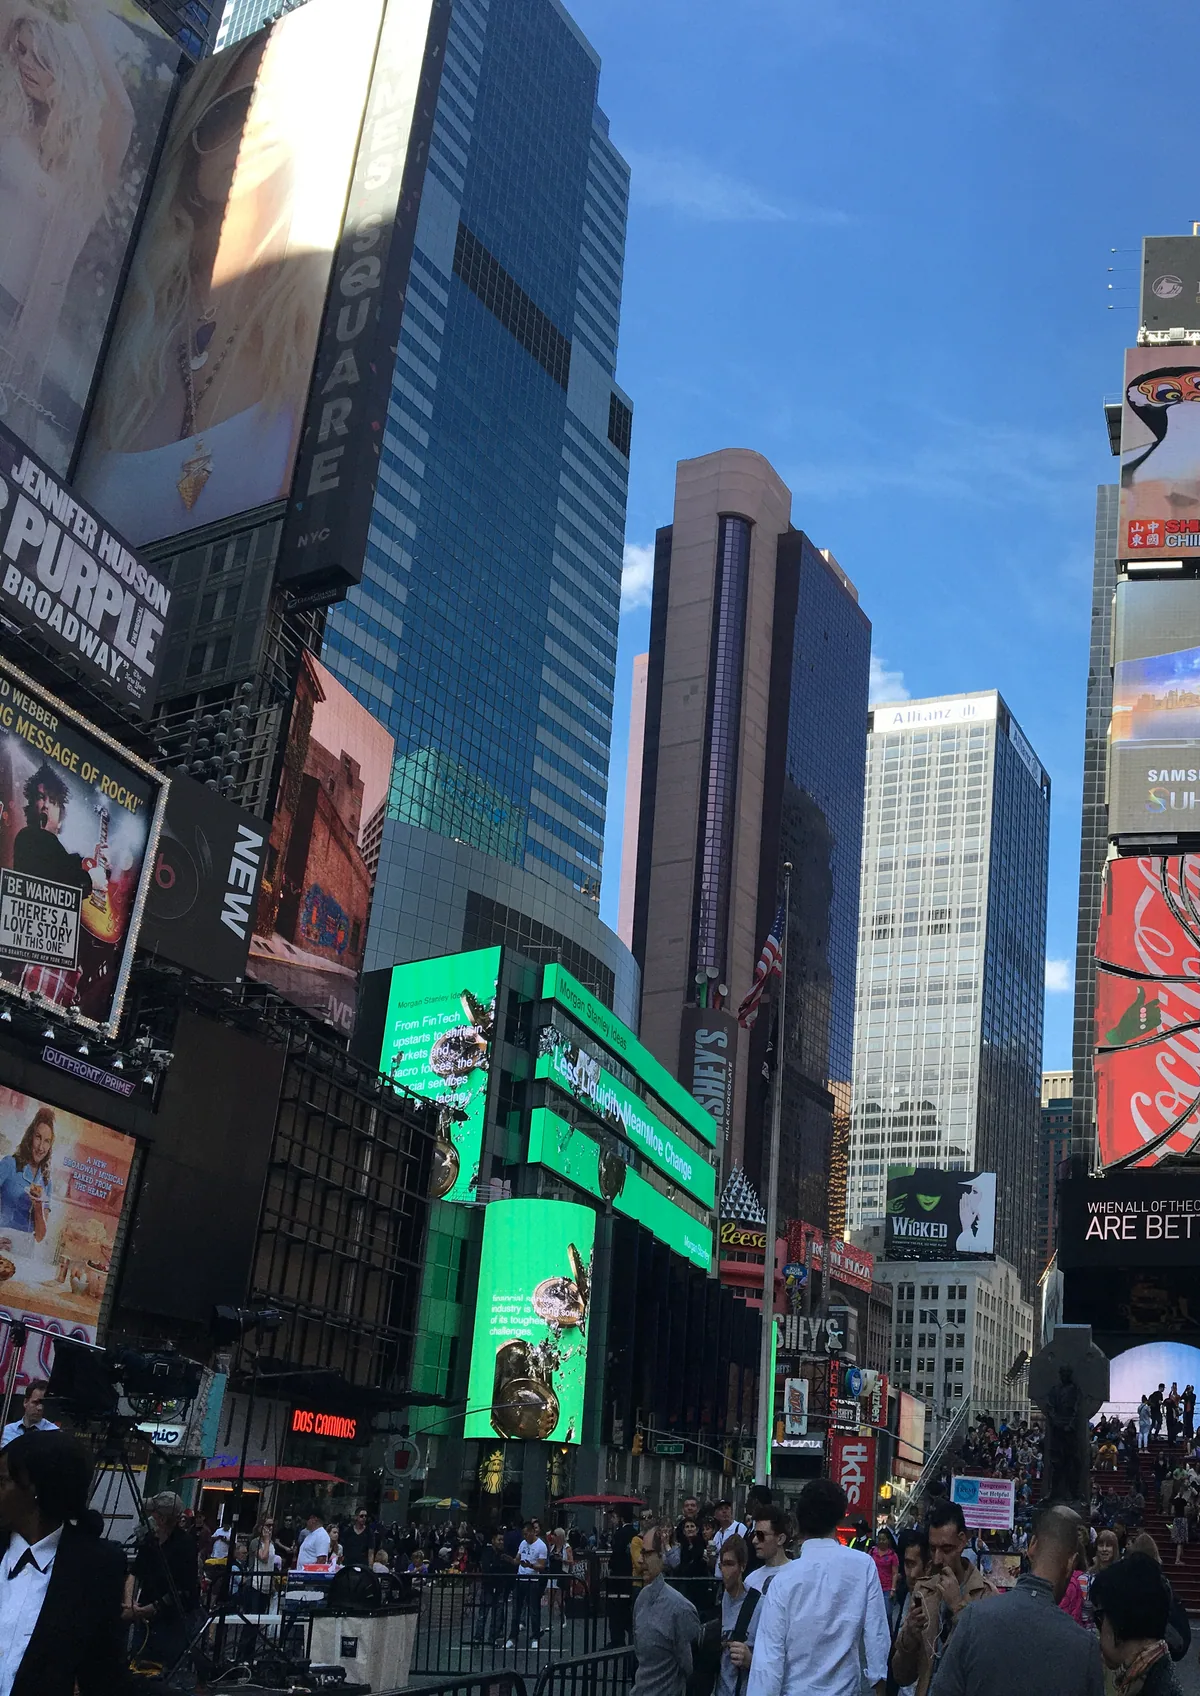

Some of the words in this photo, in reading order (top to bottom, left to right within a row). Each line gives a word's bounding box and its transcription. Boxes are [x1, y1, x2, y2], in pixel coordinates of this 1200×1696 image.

[307, 213, 385, 496] SQUARE
[11, 455, 98, 550] JENNIFER
[98, 529, 171, 617] HUDSON
[297, 527, 330, 548] NYC
[3, 493, 164, 678] PURPLE
[12, 687, 59, 733] WEBBER
[15, 715, 80, 773] MESSAGE
[81, 762, 100, 785] OF
[25, 880, 76, 909] WARNED!
[220, 824, 264, 941] NEW
[10, 899, 58, 925] THERE'S
[61, 912, 68, 928] A
[3, 915, 34, 936] LOVE
[36, 922, 73, 944] STORY
[12, 933, 22, 946] IN
[24, 935, 44, 950] THIS
[395, 1020, 419, 1032] From
[422, 1011, 461, 1027] FinTech
[559, 977, 586, 1013] Morgan
[586, 1003, 610, 1037] Stanley
[610, 1024, 627, 1050] Ideas
[393, 1033, 430, 1049] upstarts
[433, 1031, 442, 1040] to
[431, 1043, 450, 1057] and
[46, 1050, 101, 1081] OUTFRONT
[105, 1075, 132, 1095] PRIME
[457, 1057, 473, 1069] the
[553, 1045, 578, 1087] Less
[581, 1072, 621, 1122] Liquidity
[725, 1061, 733, 1117] CHOCOLATE
[665, 1141, 692, 1181] Change
[74, 1181, 87, 1192] THE
[87, 1186, 108, 1200] HEART
[94, 1178, 112, 1192] FROM
[1087, 1201, 1123, 1213] WHEN
[1124, 1201, 1149, 1213] ALL
[1150, 1200, 1168, 1212] OF
[1085, 1215, 1138, 1241] ARE
[490, 1316, 498, 1324] of
[498, 1316, 508, 1324] its
[510, 1316, 548, 1328] toughest
[491, 1304, 521, 1315] industry
[524, 1304, 531, 1313] is
[489, 1326, 534, 1338] challenges.
[292, 1409, 315, 1433] DOS
[314, 1412, 357, 1440] CAMINOS
[841, 1443, 868, 1505] tkts
